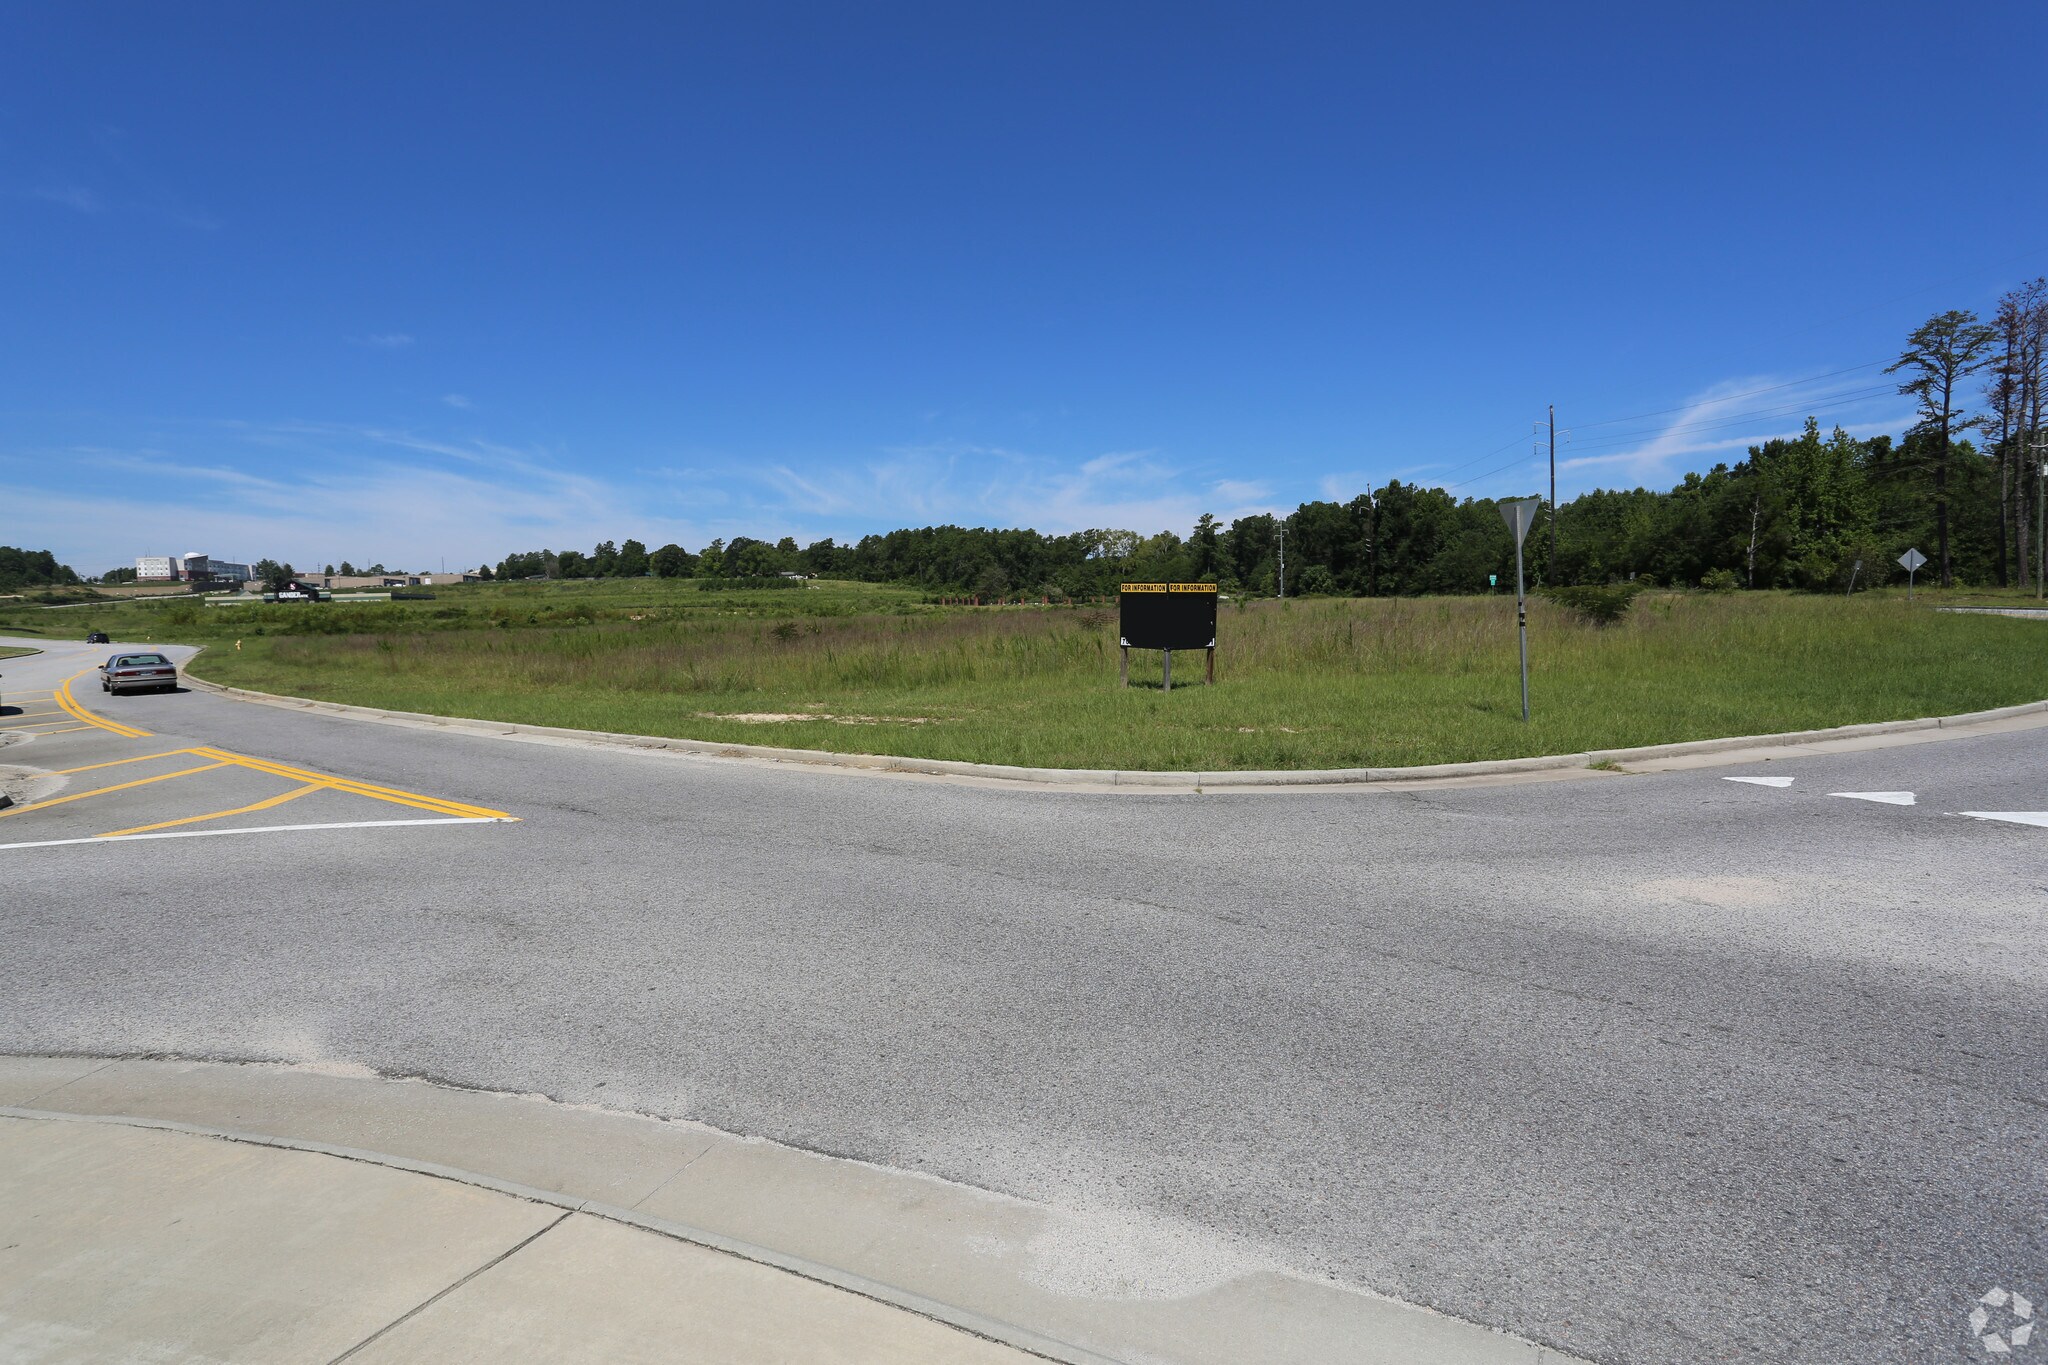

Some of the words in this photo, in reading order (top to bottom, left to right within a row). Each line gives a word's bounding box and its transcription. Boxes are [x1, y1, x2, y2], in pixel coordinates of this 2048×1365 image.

[1122, 584, 1131, 592] FOR
[1132, 584, 1165, 592] INFORMATION
[1170, 584, 1180, 592] FOR
[1182, 584, 1216, 592] INFORMATION
